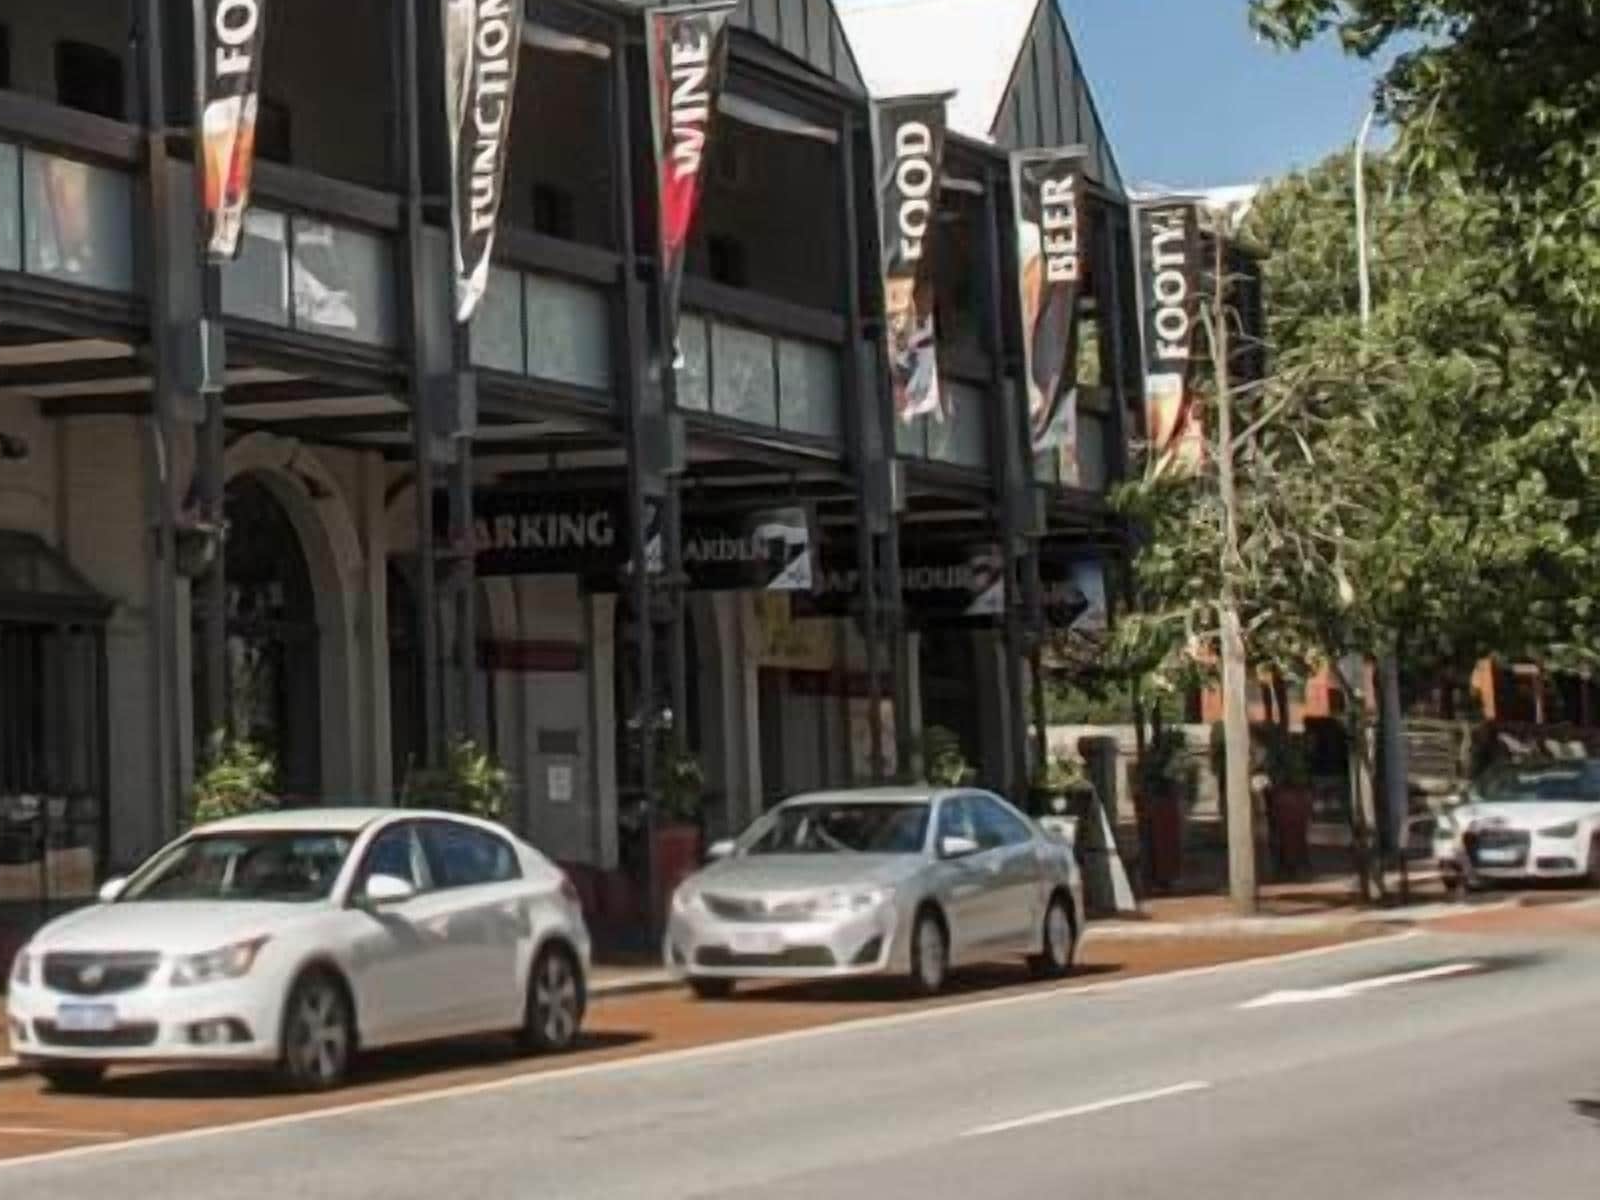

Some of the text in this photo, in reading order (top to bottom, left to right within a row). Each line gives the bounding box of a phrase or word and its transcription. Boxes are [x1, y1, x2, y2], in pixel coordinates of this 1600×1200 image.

[671, 32, 710, 184] WINE
[896, 121, 934, 261] FOOD
[1040, 172, 1081, 282] BEER
[466, 510, 616, 552] ARKING
